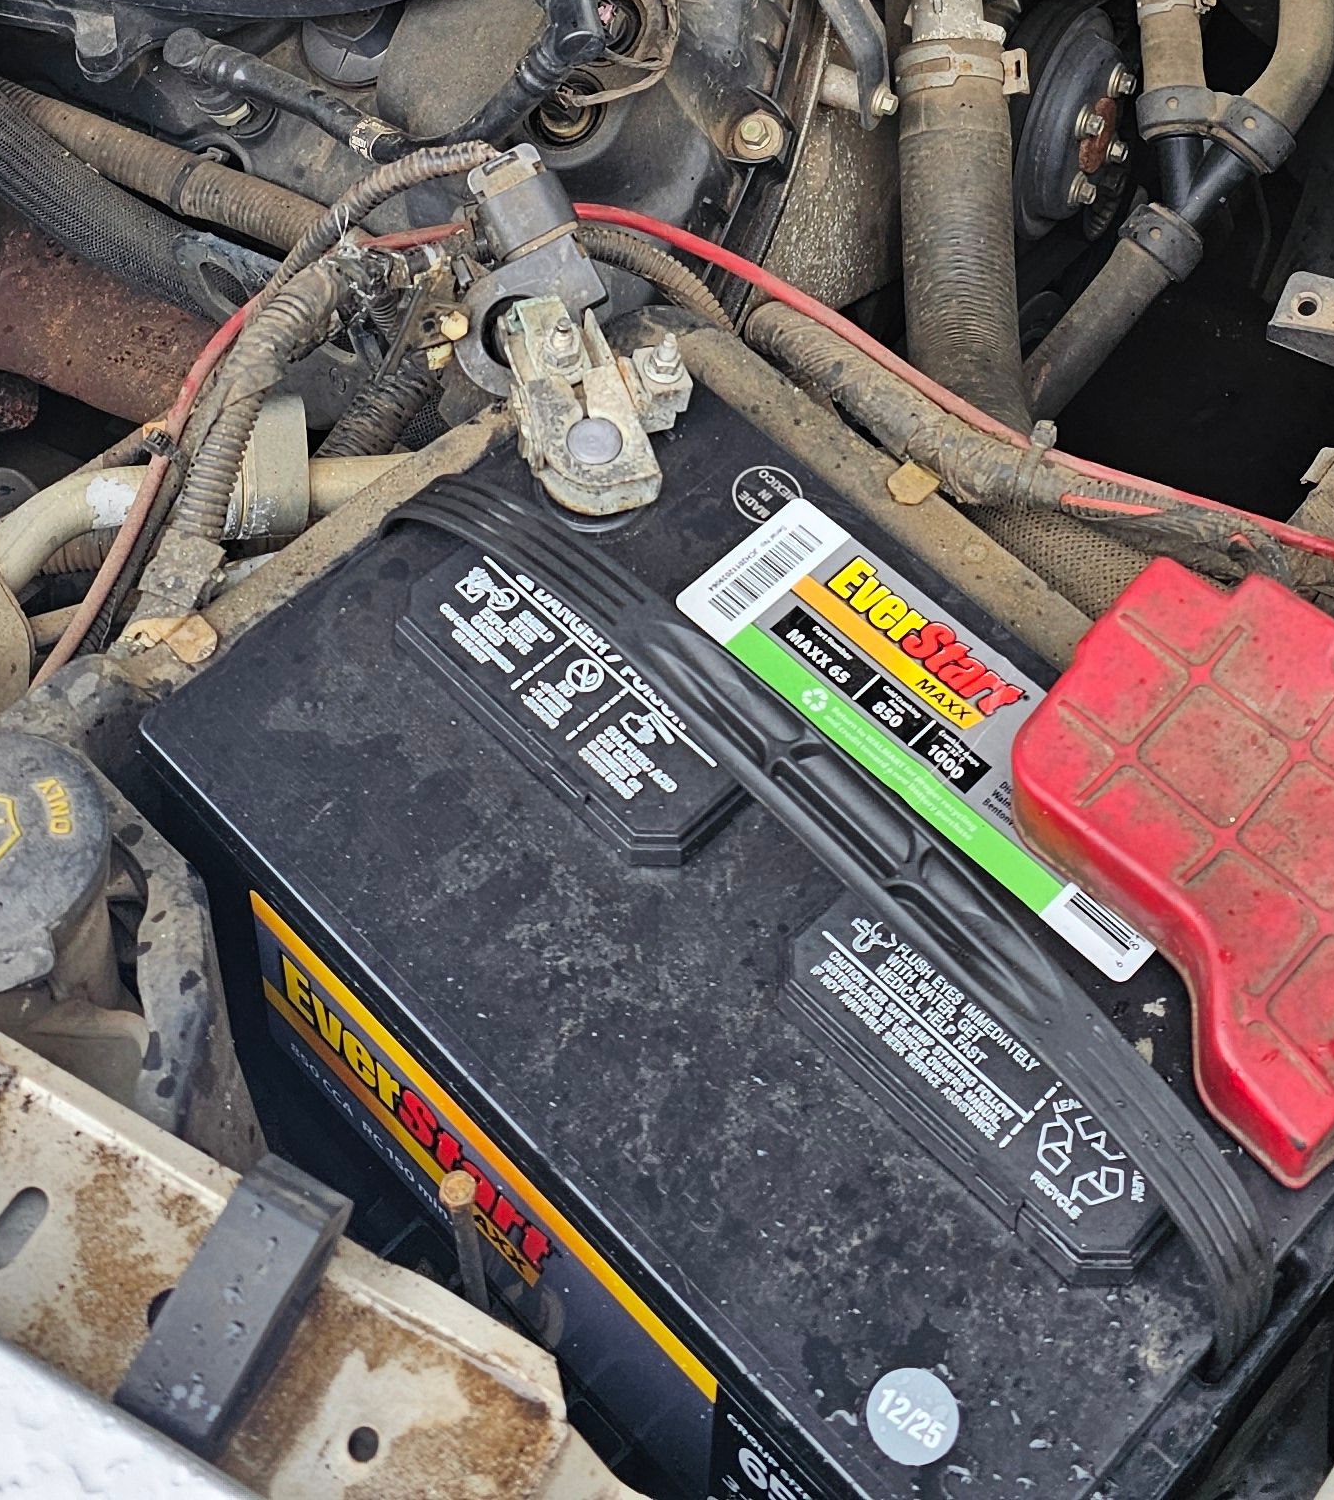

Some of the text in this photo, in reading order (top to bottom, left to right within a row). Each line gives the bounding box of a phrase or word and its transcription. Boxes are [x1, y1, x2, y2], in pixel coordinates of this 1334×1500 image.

[736, 489, 771, 520] MADE
[756, 487, 773, 503] IN
[467, 612, 506, 648] GASES
[476, 604, 534, 658] EXPLOSIVE
[507, 616, 539, 646] EYES
[516, 607, 557, 646] SHIELD
[810, 624, 831, 643] Part
[823, 553, 1027, 723] EverStart
[782, 625, 852, 687] MAXX 65
[554, 678, 577, 700] NO
[870, 698, 905, 730] 850
[881, 683, 898, 699] Cold
[915, 674, 972, 724] MAXX
[601, 723, 679, 795] SULFURIC ACID
[863, 733, 906, 769] WALMART
[923, 741, 968, 782] 1000
[36, 777, 72, 835] ONLY
[818, 958, 884, 1019] INSTRUCTIONS
[871, 961, 989, 1068] MEDICAL HELP FAST
[882, 951, 920, 985] WITH
[953, 1015, 987, 1046] GET
[891, 941, 1041, 1074] FLUSH EYES IMMEDIATELY
[808, 963, 825, 980] IF
[817, 972, 844, 997] NOT
[835, 989, 888, 1036] AVAILABLE
[878, 1028, 910, 1058] SEEK
[900, 1049, 947, 1091] SERVICE
[877, 1010, 896, 1029] IN
[886, 1021, 932, 1061] VEHICLE
[863, 982, 891, 1008] FOR
[882, 999, 914, 1029] SAFE
[905, 1020, 937, 1049] JUMP
[926, 1042, 982, 1090] STARTING
[971, 1081, 1018, 1123] FOLLOW
[286, 1039, 322, 1080] 850
[318, 1076, 357, 1120] CCA
[357, 1118, 387, 1152] RC
[382, 1145, 416, 1183] 150
[1026, 1168, 1085, 1222] RECYCLE
[723, 1411, 782, 1470] GROUP
[875, 1384, 948, 1451] 12/25
[733, 1444, 796, 1500] 65
